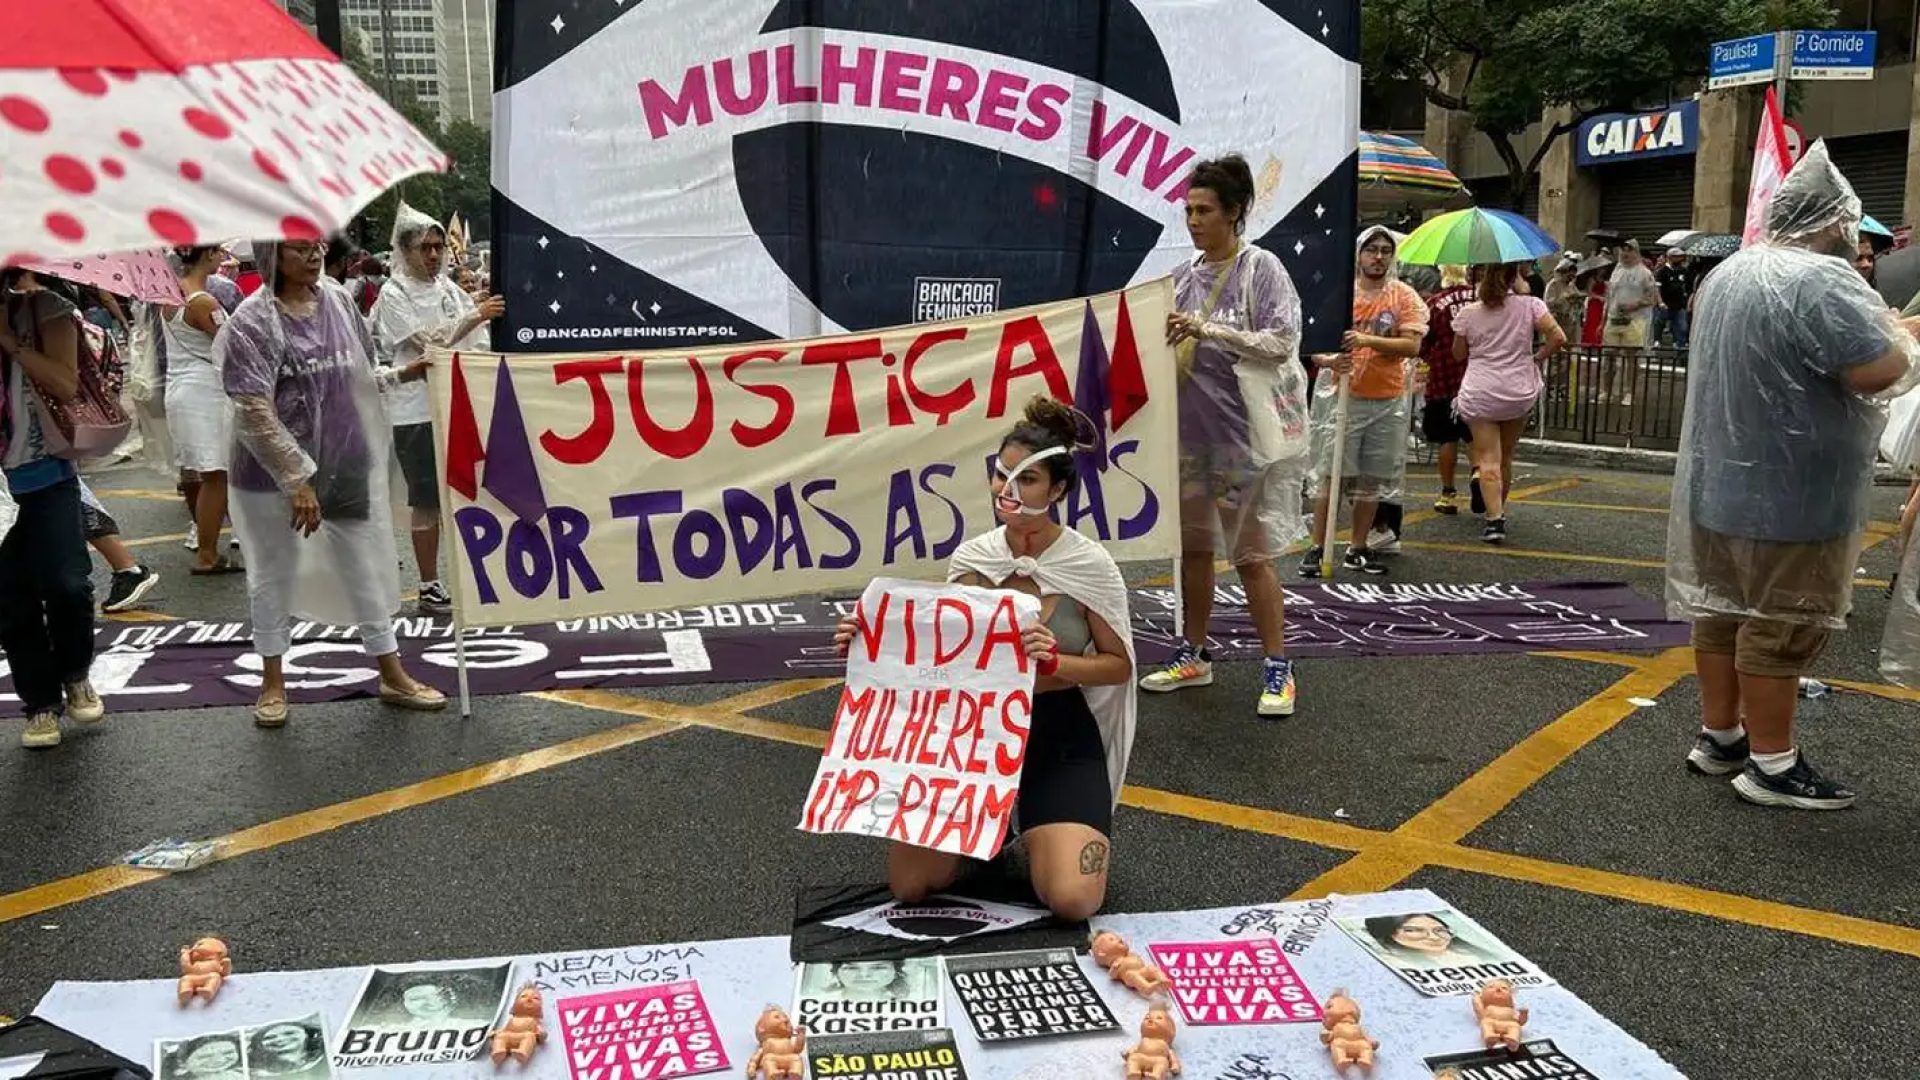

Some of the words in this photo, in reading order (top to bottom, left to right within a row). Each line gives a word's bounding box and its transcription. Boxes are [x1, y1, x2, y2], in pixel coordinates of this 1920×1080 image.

[1714, 41, 1758, 62] Paulista
[1808, 33, 1864, 52] Gomide
[637, 44, 1071, 141] MULHERES
[1587, 111, 1684, 156] CAIXA
[919, 282, 995, 302] BANCADA
[516, 325, 738, 343] @BANCADAFEMINISTAPSOL
[455, 505, 604, 604] POR
[609, 479, 862, 582] TODAS
[884, 464, 965, 562] AS
[855, 592, 1028, 673] VIDA
[824, 686, 1031, 776] MULHERES
[535, 954, 615, 978] NEM
[624, 946, 704, 965] UMA
[1158, 948, 1278, 967] VIVAS
[955, 964, 1079, 990] QUANTAS
[1168, 965, 1289, 978] QUEREMOS
[1175, 975, 1296, 988] MULHERES
[1400, 960, 1529, 986] Brenna
[962, 979, 1088, 1001] MULHERES
[1178, 986, 1305, 1005] VIVAS
[564, 994, 697, 1027] VIVAS
[800, 998, 938, 1015] Catarina
[969, 991, 1096, 1015] ACEITAMOS
[1185, 1002, 1316, 1021] VIVAS
[570, 1010, 703, 1038] QUEREMOS
[798, 1014, 938, 1035] Kasten
[975, 1005, 1109, 1032] PERDER
[573, 1020, 707, 1050] MULHERES
[410, 1052, 434, 1062] da
[573, 1031, 712, 1069] VIVAS
[815, 1053, 866, 1074] SÃO
[872, 1048, 955, 1071] PAULO
[577, 1051, 719, 1080] VIVAS
[1459, 1055, 1577, 1080] UANTAS
